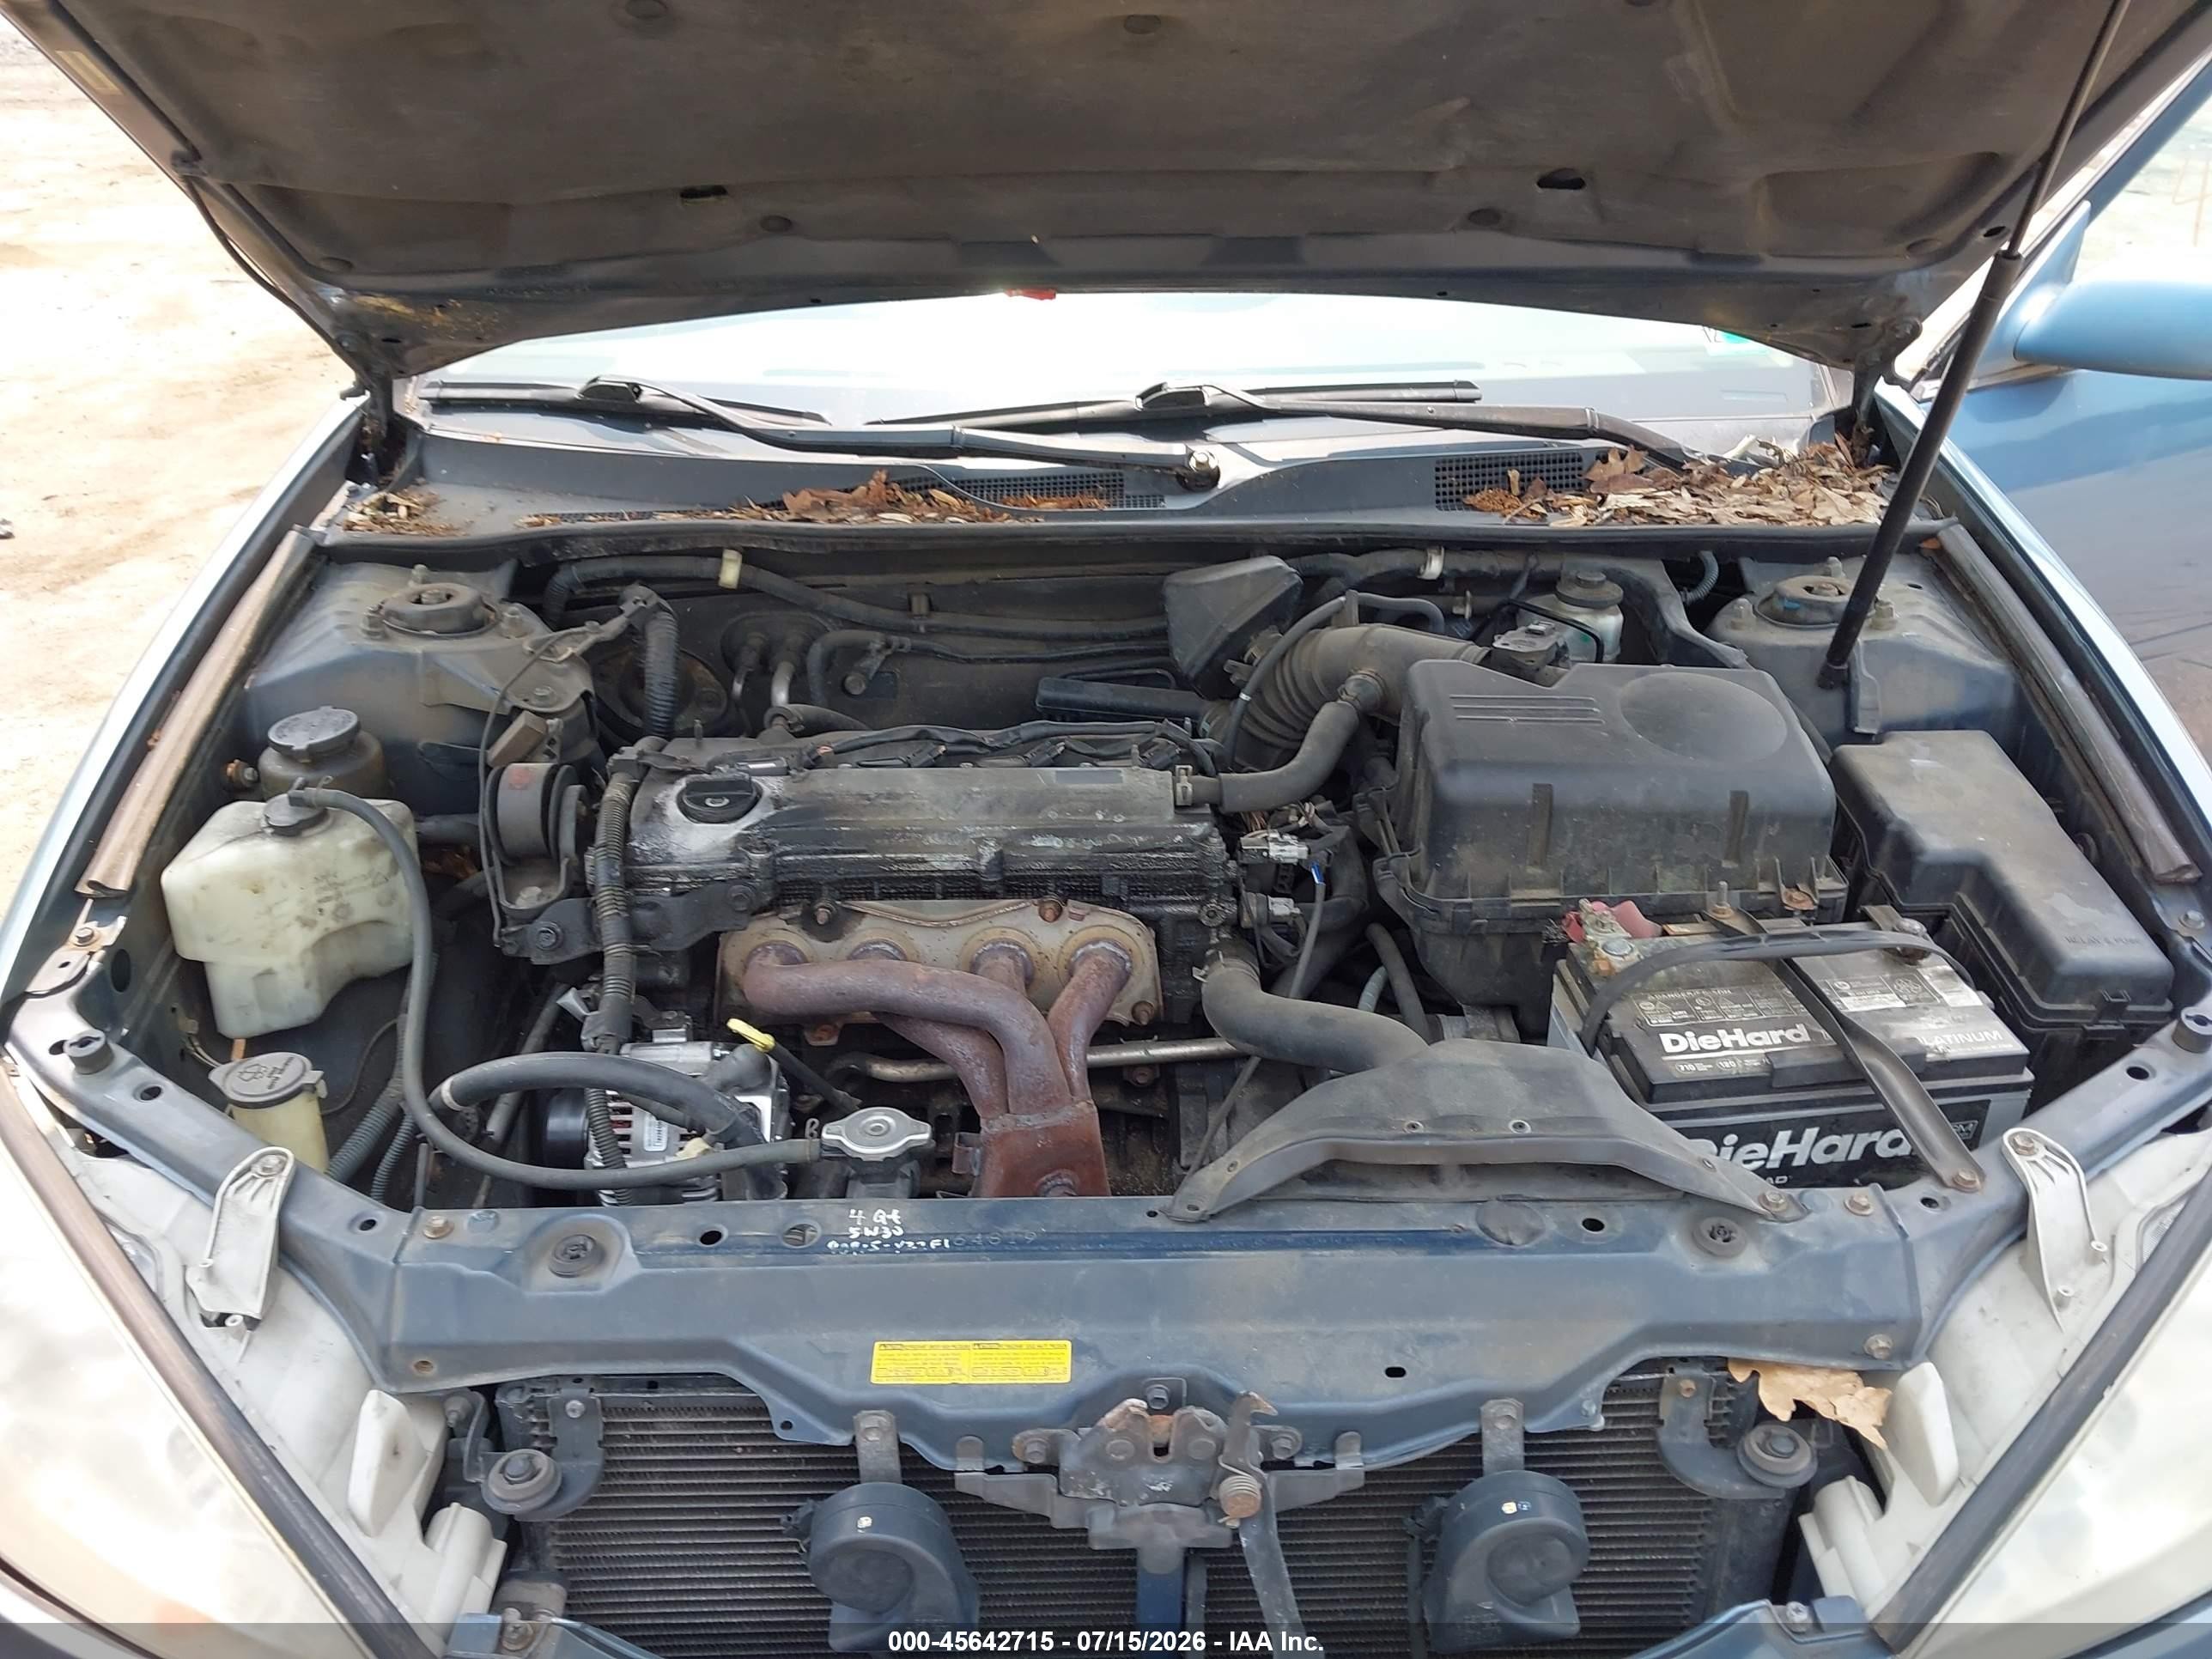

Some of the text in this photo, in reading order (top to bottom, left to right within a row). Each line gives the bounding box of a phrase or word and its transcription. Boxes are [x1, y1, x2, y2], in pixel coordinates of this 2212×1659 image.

[1659, 1023, 1812, 1054] DieHard
[848, 1208, 866, 1225] 4
[848, 1225, 904, 1239] 5W30
